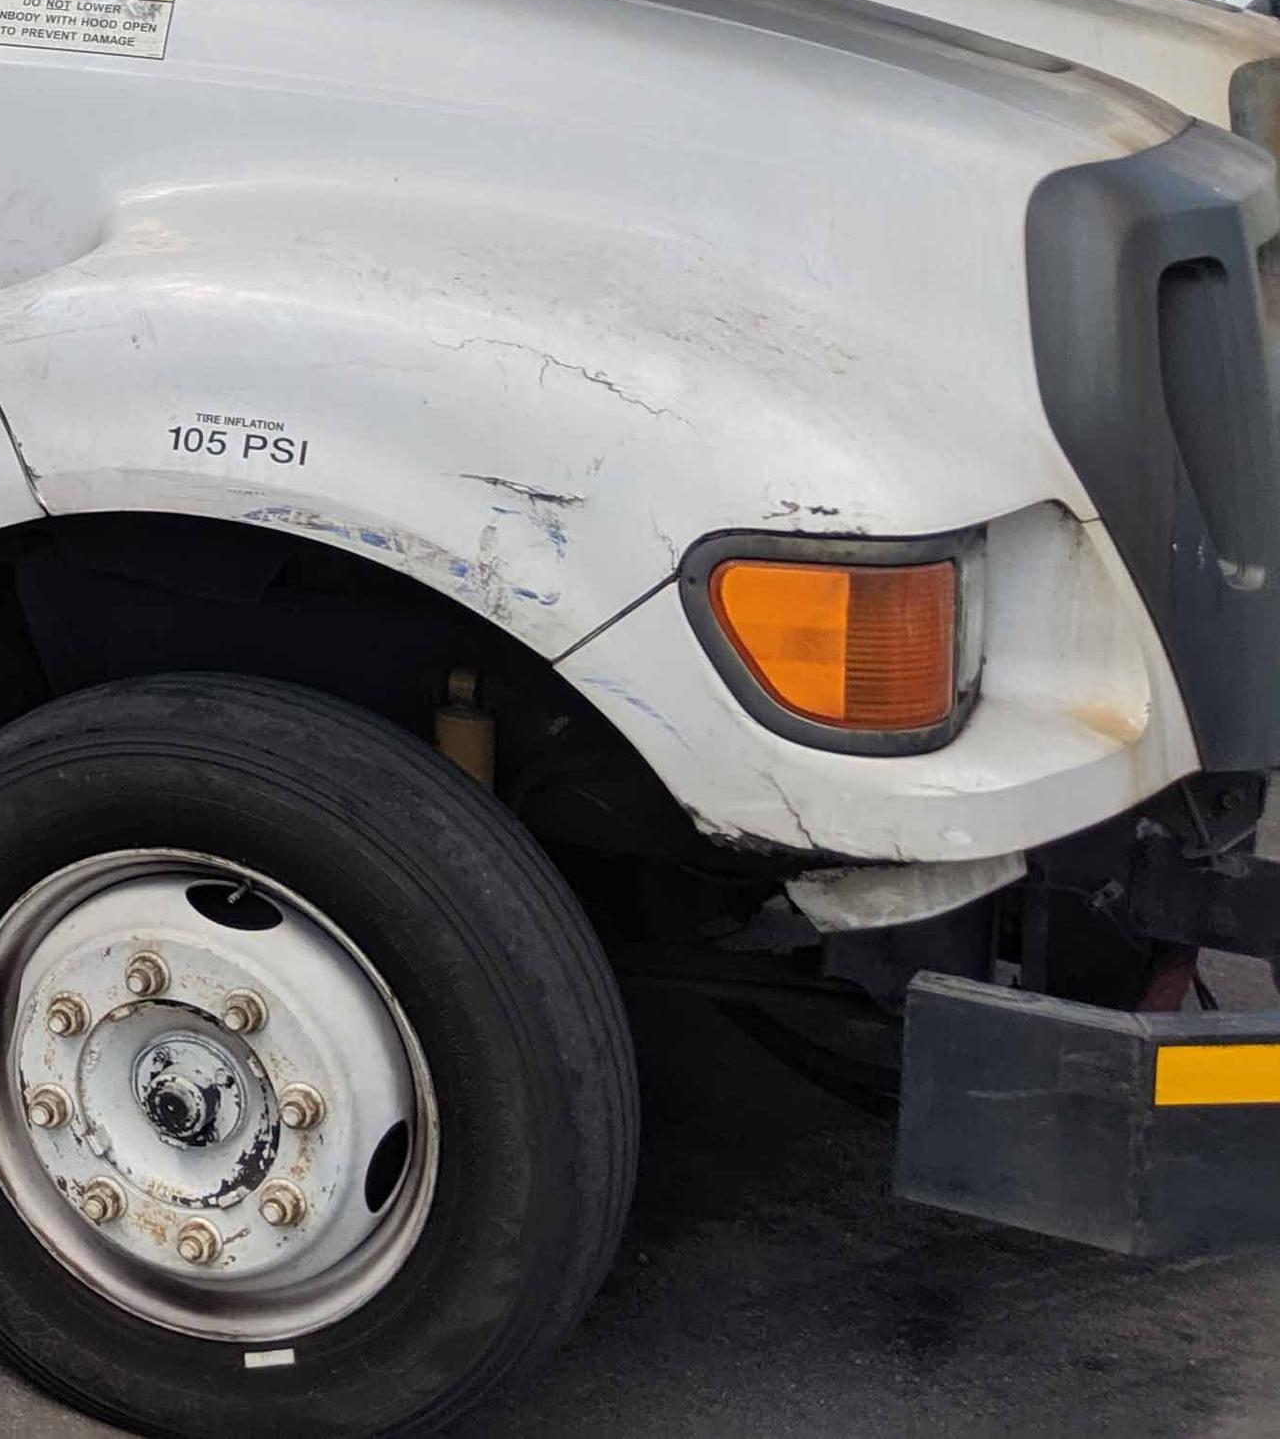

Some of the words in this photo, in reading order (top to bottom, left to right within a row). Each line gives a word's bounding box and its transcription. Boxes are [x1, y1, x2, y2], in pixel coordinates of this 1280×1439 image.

[76, 1, 122, 15] LOWER
[45, 13, 77, 26] WITH
[80, 17, 118, 30] HOOD
[122, 20, 158, 34] OPEN
[0, 25, 17, 37] TO
[20, 27, 79, 42] PREVENT
[82, 33, 137, 48] DAMAGE
[195, 412, 221, 425] TIRE
[223, 416, 285, 432] INFLATION
[168, 425, 228, 457] 105
[242, 433, 309, 466] PSI
